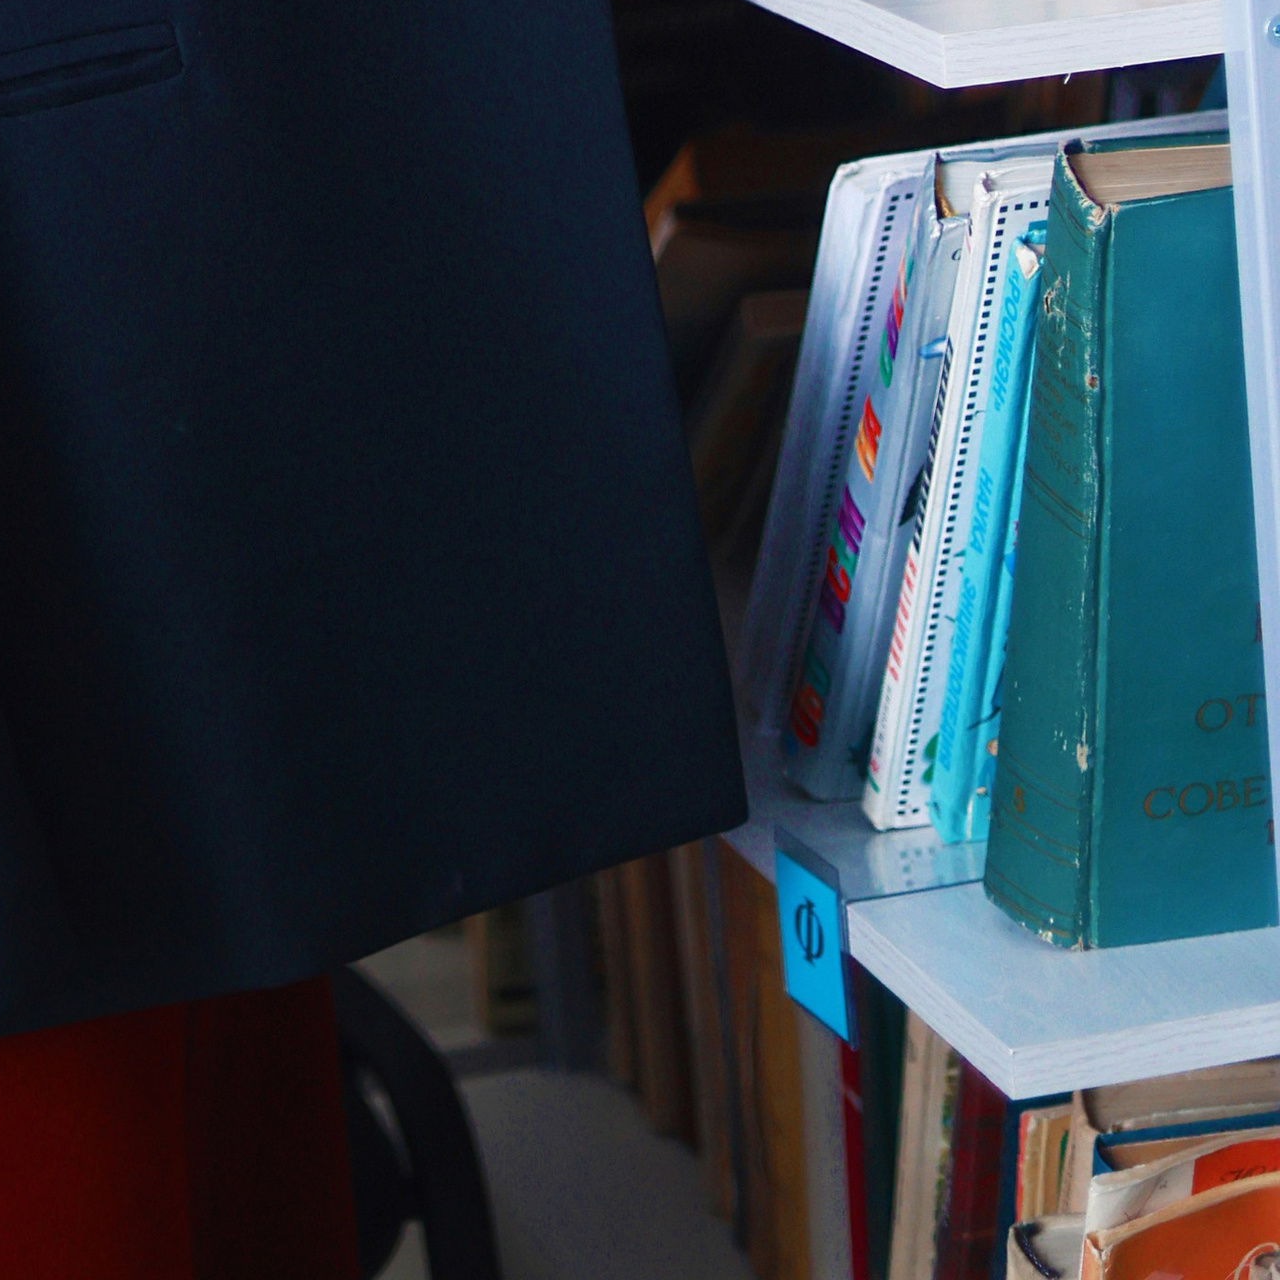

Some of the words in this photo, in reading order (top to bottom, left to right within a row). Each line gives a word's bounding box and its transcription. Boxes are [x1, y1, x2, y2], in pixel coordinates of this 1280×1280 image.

[854, 393, 882, 484] НА
[969, 465, 994, 557] НАУКА
[938, 576, 977, 772] ЭНЦИКЛОПЕДИЯ
[795, 896, 824, 966] Ф
